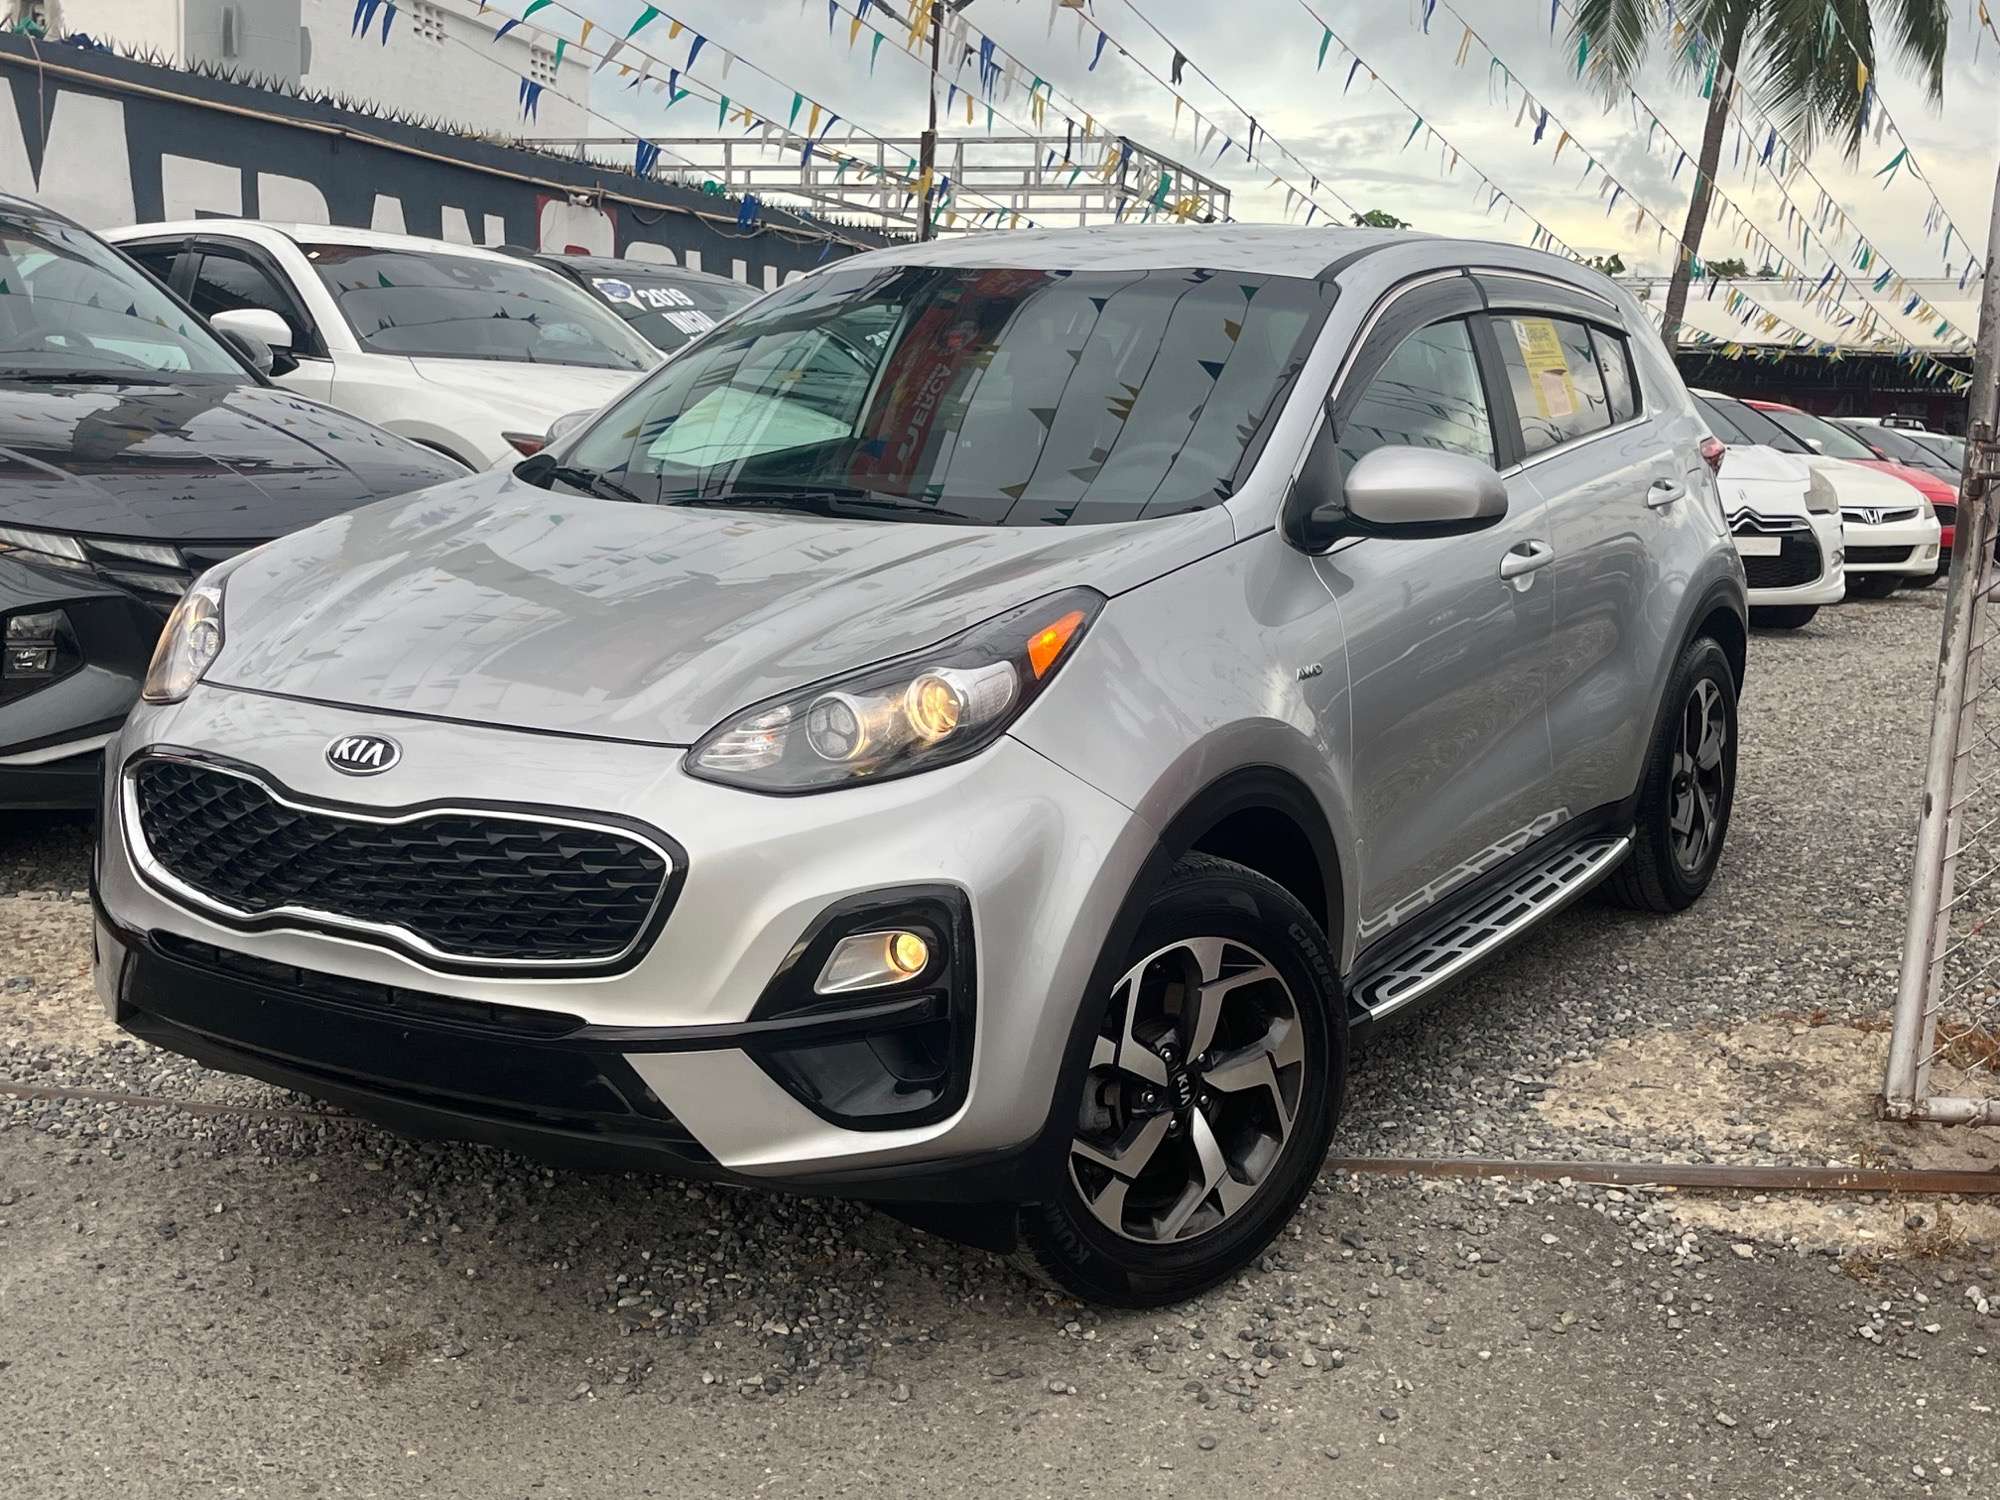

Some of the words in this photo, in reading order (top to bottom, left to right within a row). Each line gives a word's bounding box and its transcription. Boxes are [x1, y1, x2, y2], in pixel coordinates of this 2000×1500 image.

[637, 288, 695, 308] 2019
[333, 738, 384, 767] KIA
[1177, 1073, 1191, 1105] KIA
